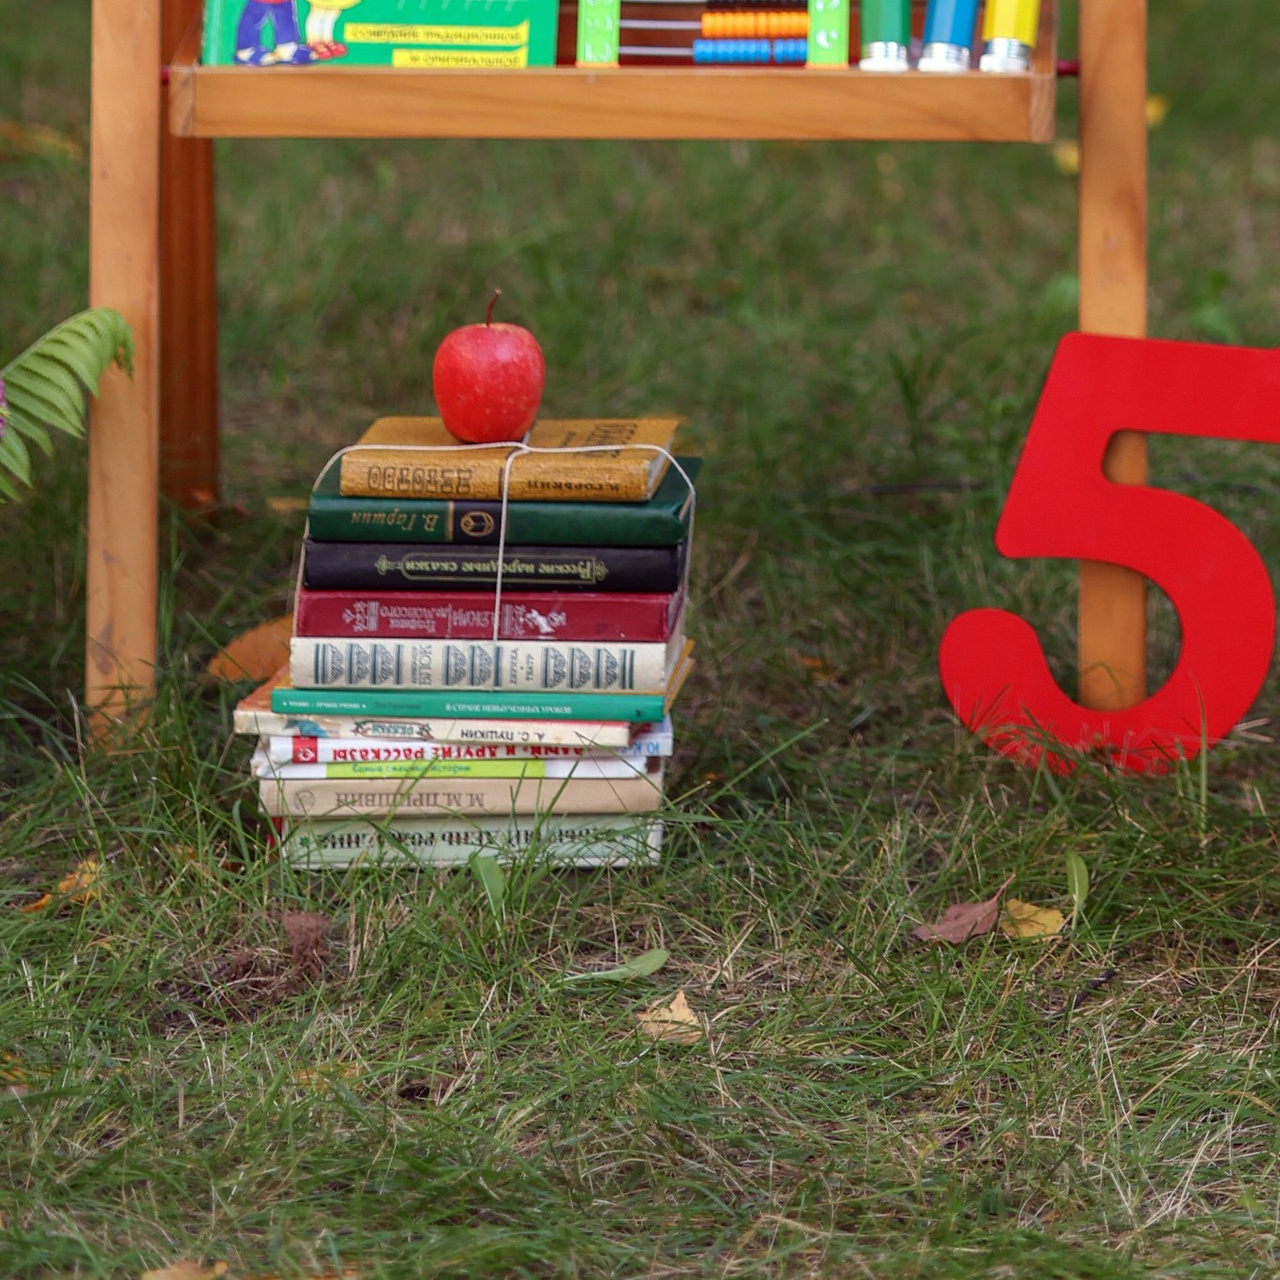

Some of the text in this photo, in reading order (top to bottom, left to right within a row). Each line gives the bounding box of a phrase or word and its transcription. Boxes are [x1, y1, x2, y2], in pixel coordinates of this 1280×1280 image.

[351, 508, 440, 532] В. Гаршин
[405, 558, 458, 573] сказки
[538, 560, 592, 580] Русские
[460, 728, 546, 742] А. С. ПУШКИН
[443, 792, 463, 808] М.
[465, 792, 485, 808] М.
